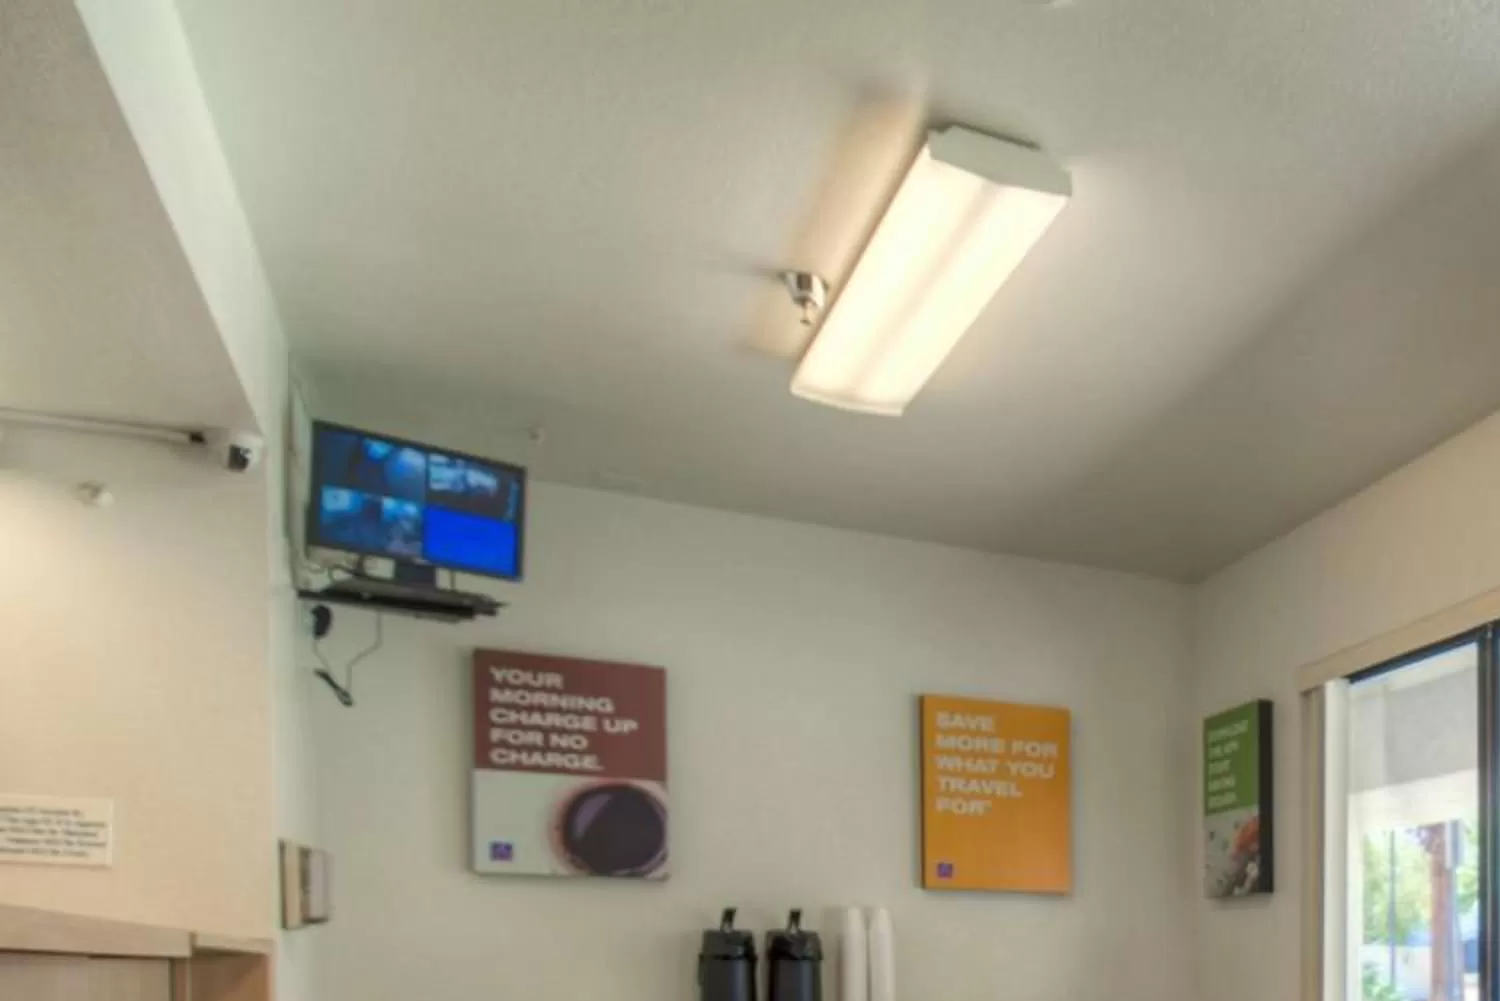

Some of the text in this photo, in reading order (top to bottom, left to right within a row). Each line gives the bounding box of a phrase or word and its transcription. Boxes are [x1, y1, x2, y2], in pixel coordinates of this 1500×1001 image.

[489, 666, 564, 690] YOUR
[488, 688, 615, 713] MORNING
[488, 707, 639, 735] CHARGE UP
[489, 727, 588, 750] FOR NO
[1011, 738, 1058, 759] FOR
[1007, 760, 1055, 779] YOU
[938, 775, 1024, 798] TRAVEL
